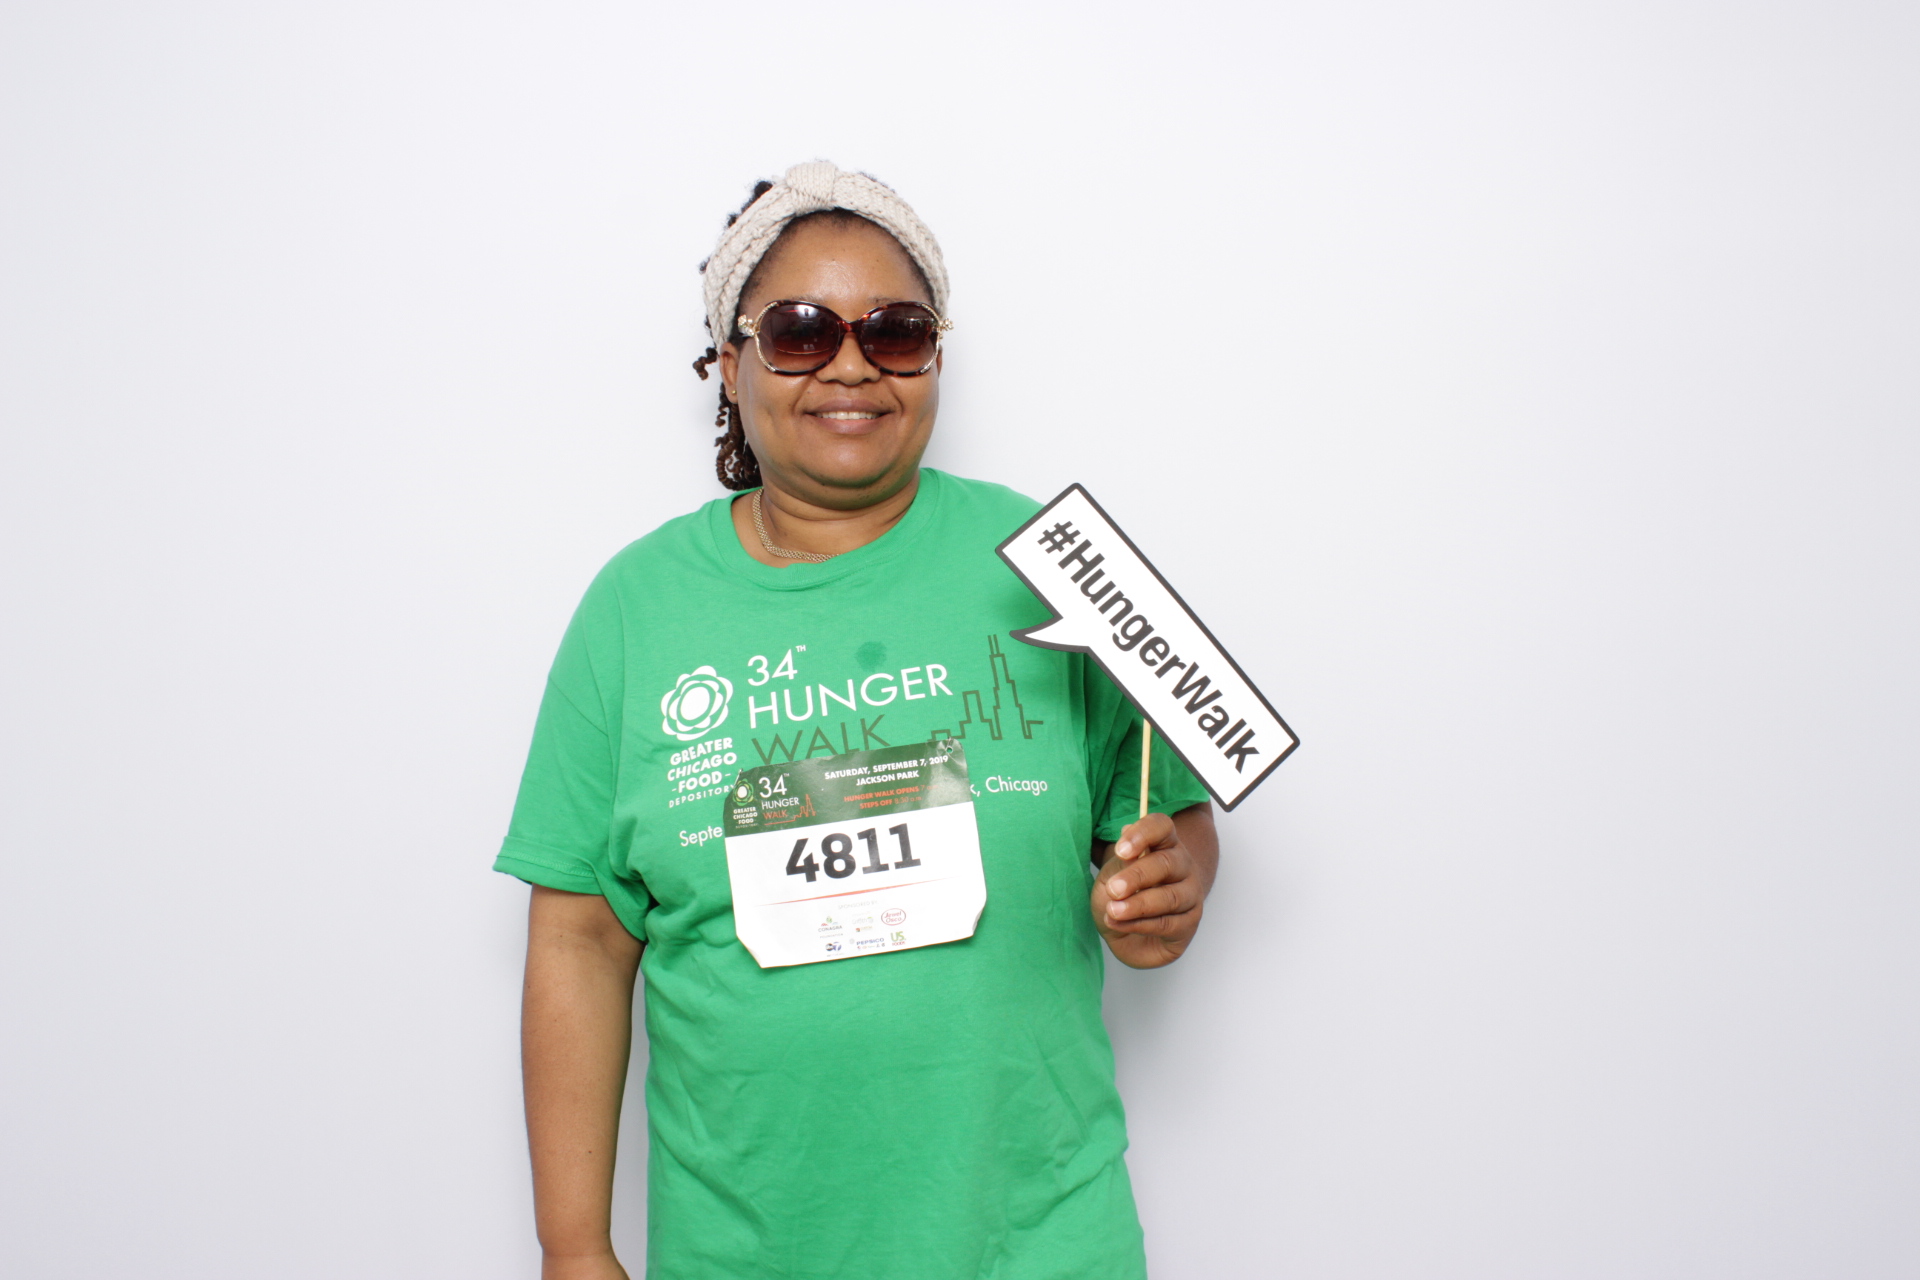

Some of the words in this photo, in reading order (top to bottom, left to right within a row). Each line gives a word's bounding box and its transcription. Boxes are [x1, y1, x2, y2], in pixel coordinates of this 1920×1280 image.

[1037, 521, 1260, 774] #HungerWalk
[748, 663, 954, 729] HUNGER
[751, 713, 891, 765] WALK
[670, 737, 733, 766] GREATER
[667, 752, 737, 781] CHICAGO
[824, 766, 871, 780] SATURDAY,
[872, 760, 919, 774] SEPTEMBER
[919, 758, 927, 767] 7,
[928, 755, 949, 765] 2019
[856, 774, 896, 786] JACKSON
[896, 770, 920, 780] PARK
[985, 775, 1048, 796] Chicago
[761, 797, 800, 810] HUNGER
[843, 793, 874, 803] HUNGER
[875, 789, 895, 798] WALK
[895, 786, 920, 795] OPENS
[733, 806, 757, 814] GREATER
[733, 812, 758, 820] CHICAGO
[763, 810, 789, 819] WALK
[859, 801, 879, 810] STEPS
[679, 825, 723, 847] Septe
[785, 822, 922, 883] 4811
[856, 938, 885, 946] PEPSICO
